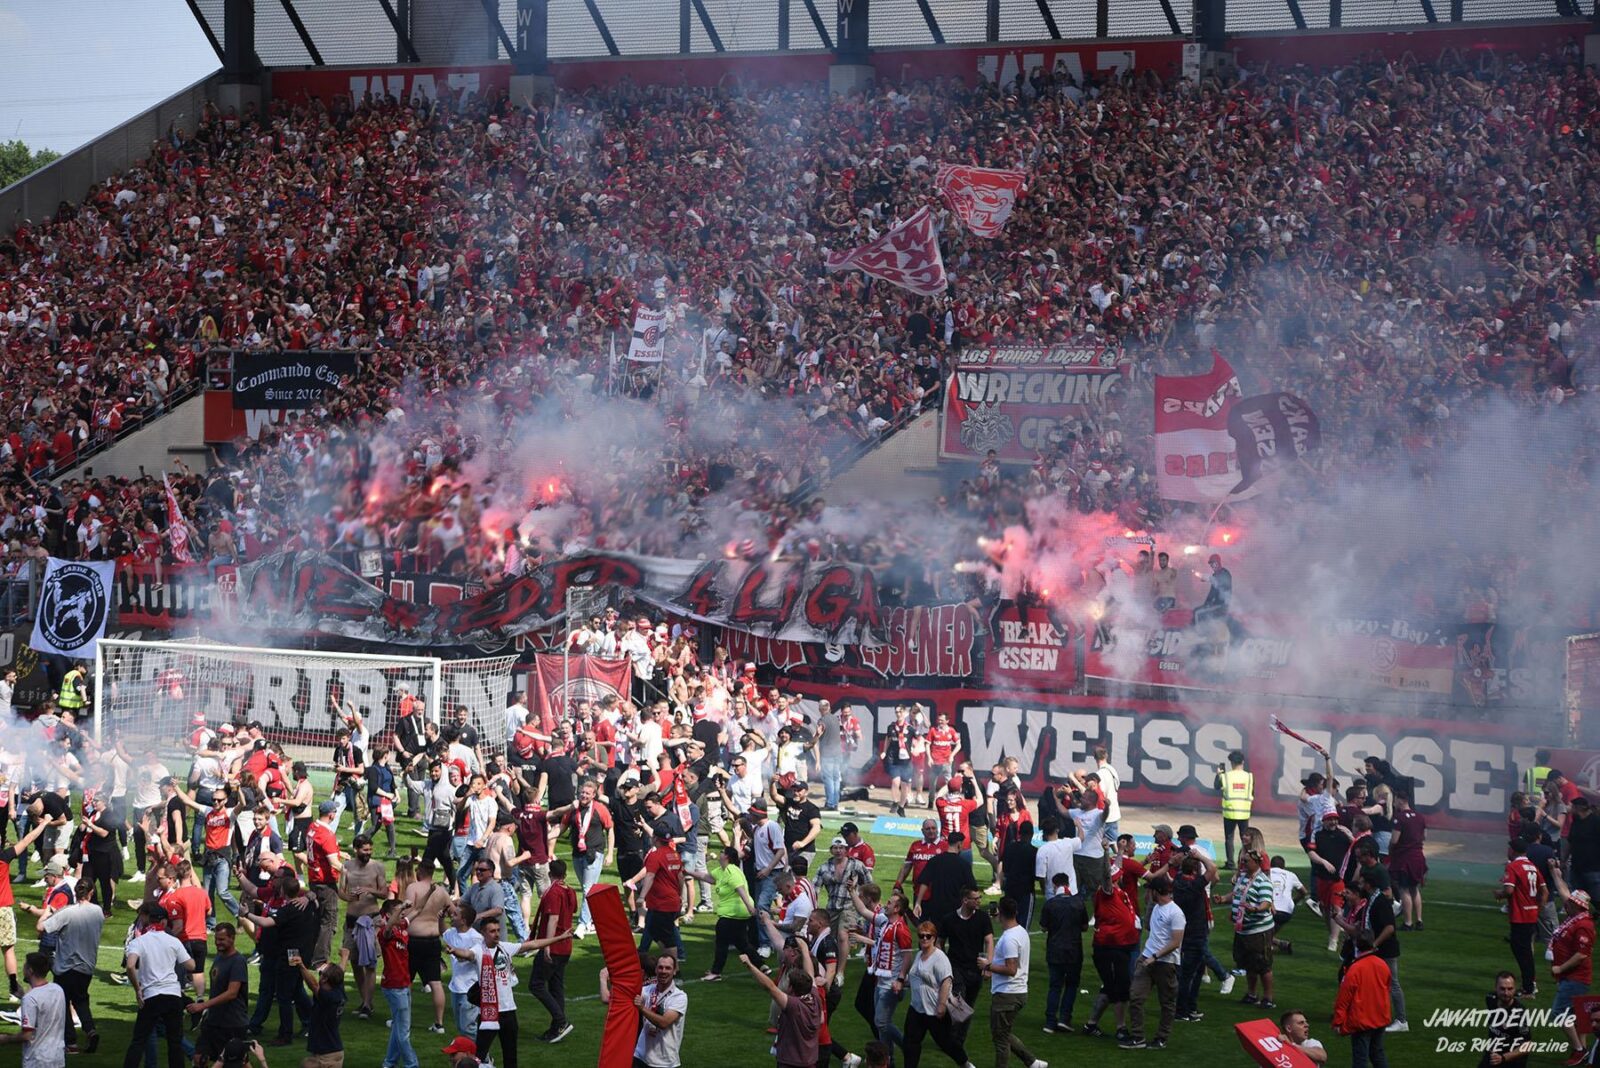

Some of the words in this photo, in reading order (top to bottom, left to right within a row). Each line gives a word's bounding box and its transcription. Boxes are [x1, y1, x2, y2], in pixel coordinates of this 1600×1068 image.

[517, 9, 532, 26] W
[960, 349, 990, 363] LOS
[236, 362, 312, 392] Commando
[264, 387, 293, 400] Since
[296, 388, 322, 400] 2012
[998, 646, 1059, 671] ESSEN
[961, 706, 1248, 791] WEISS
[1276, 728, 1536, 813] ESSE
[879, 941, 891, 970] RWE
